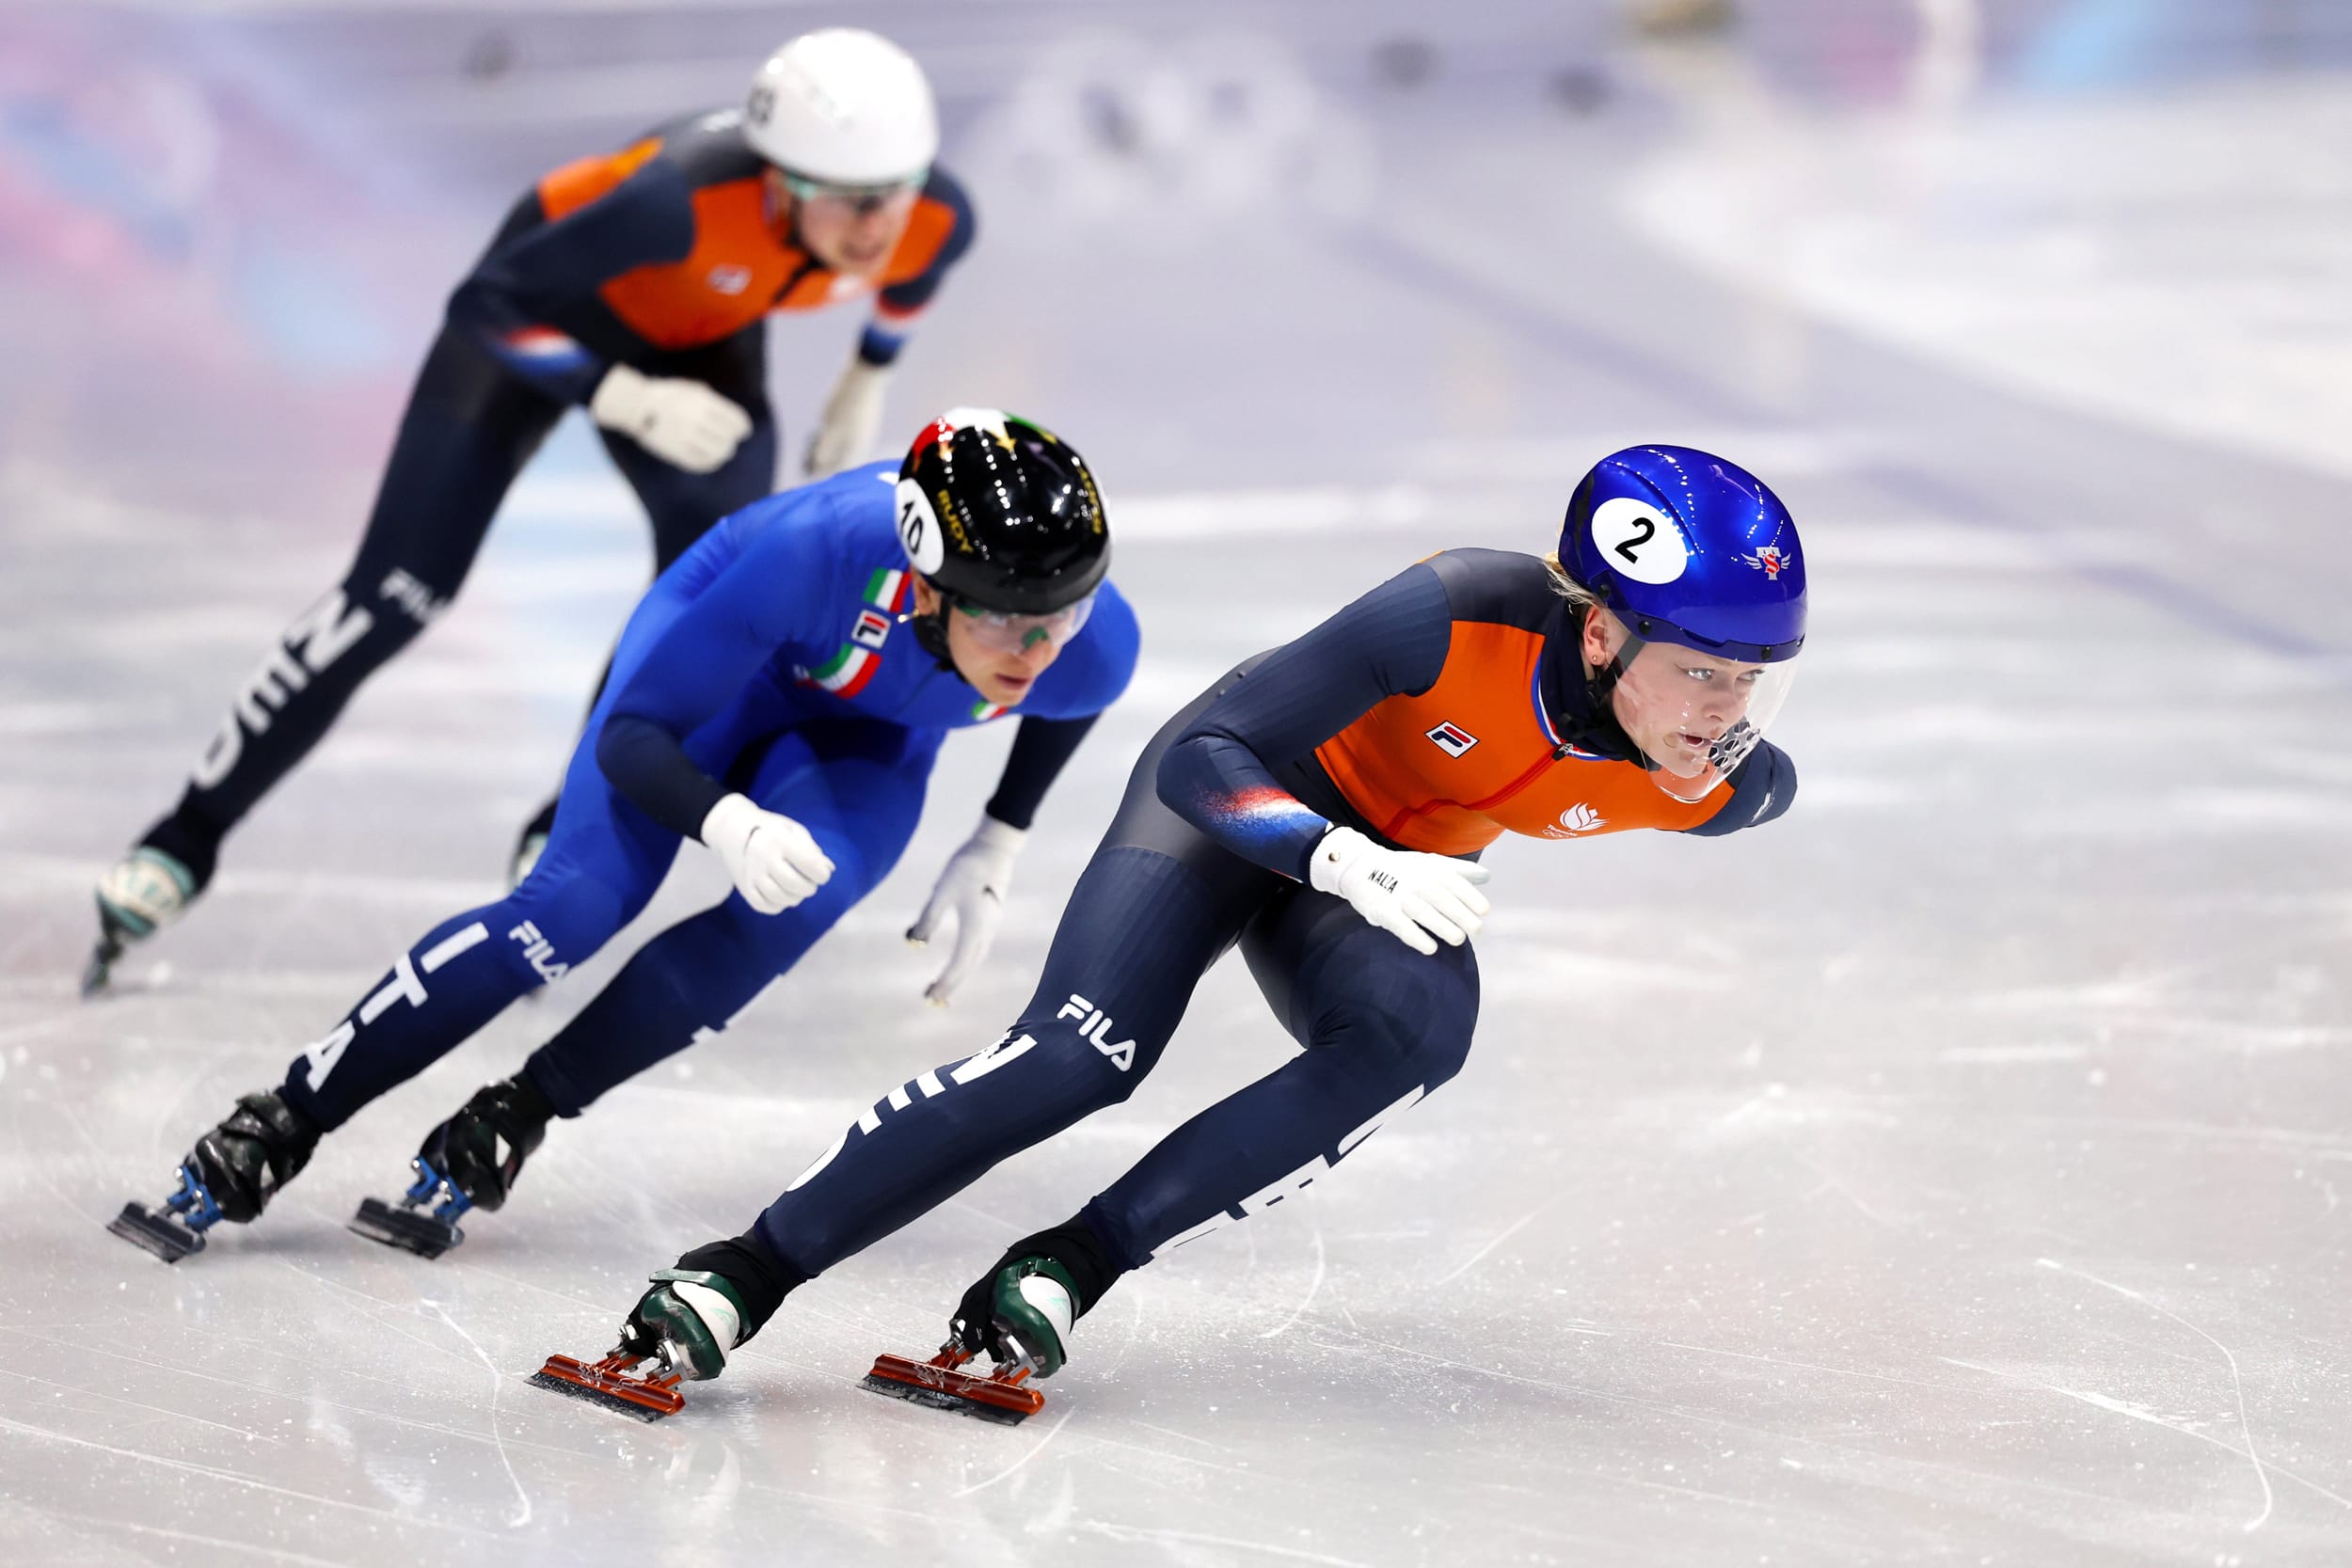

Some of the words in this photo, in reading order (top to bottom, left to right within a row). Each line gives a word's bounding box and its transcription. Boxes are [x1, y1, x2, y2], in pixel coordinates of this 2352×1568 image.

[901, 501, 923, 556] 10
[1614, 517, 1655, 564] 2
[508, 920, 568, 985] FILA
[1057, 993, 1136, 1072] FILA
